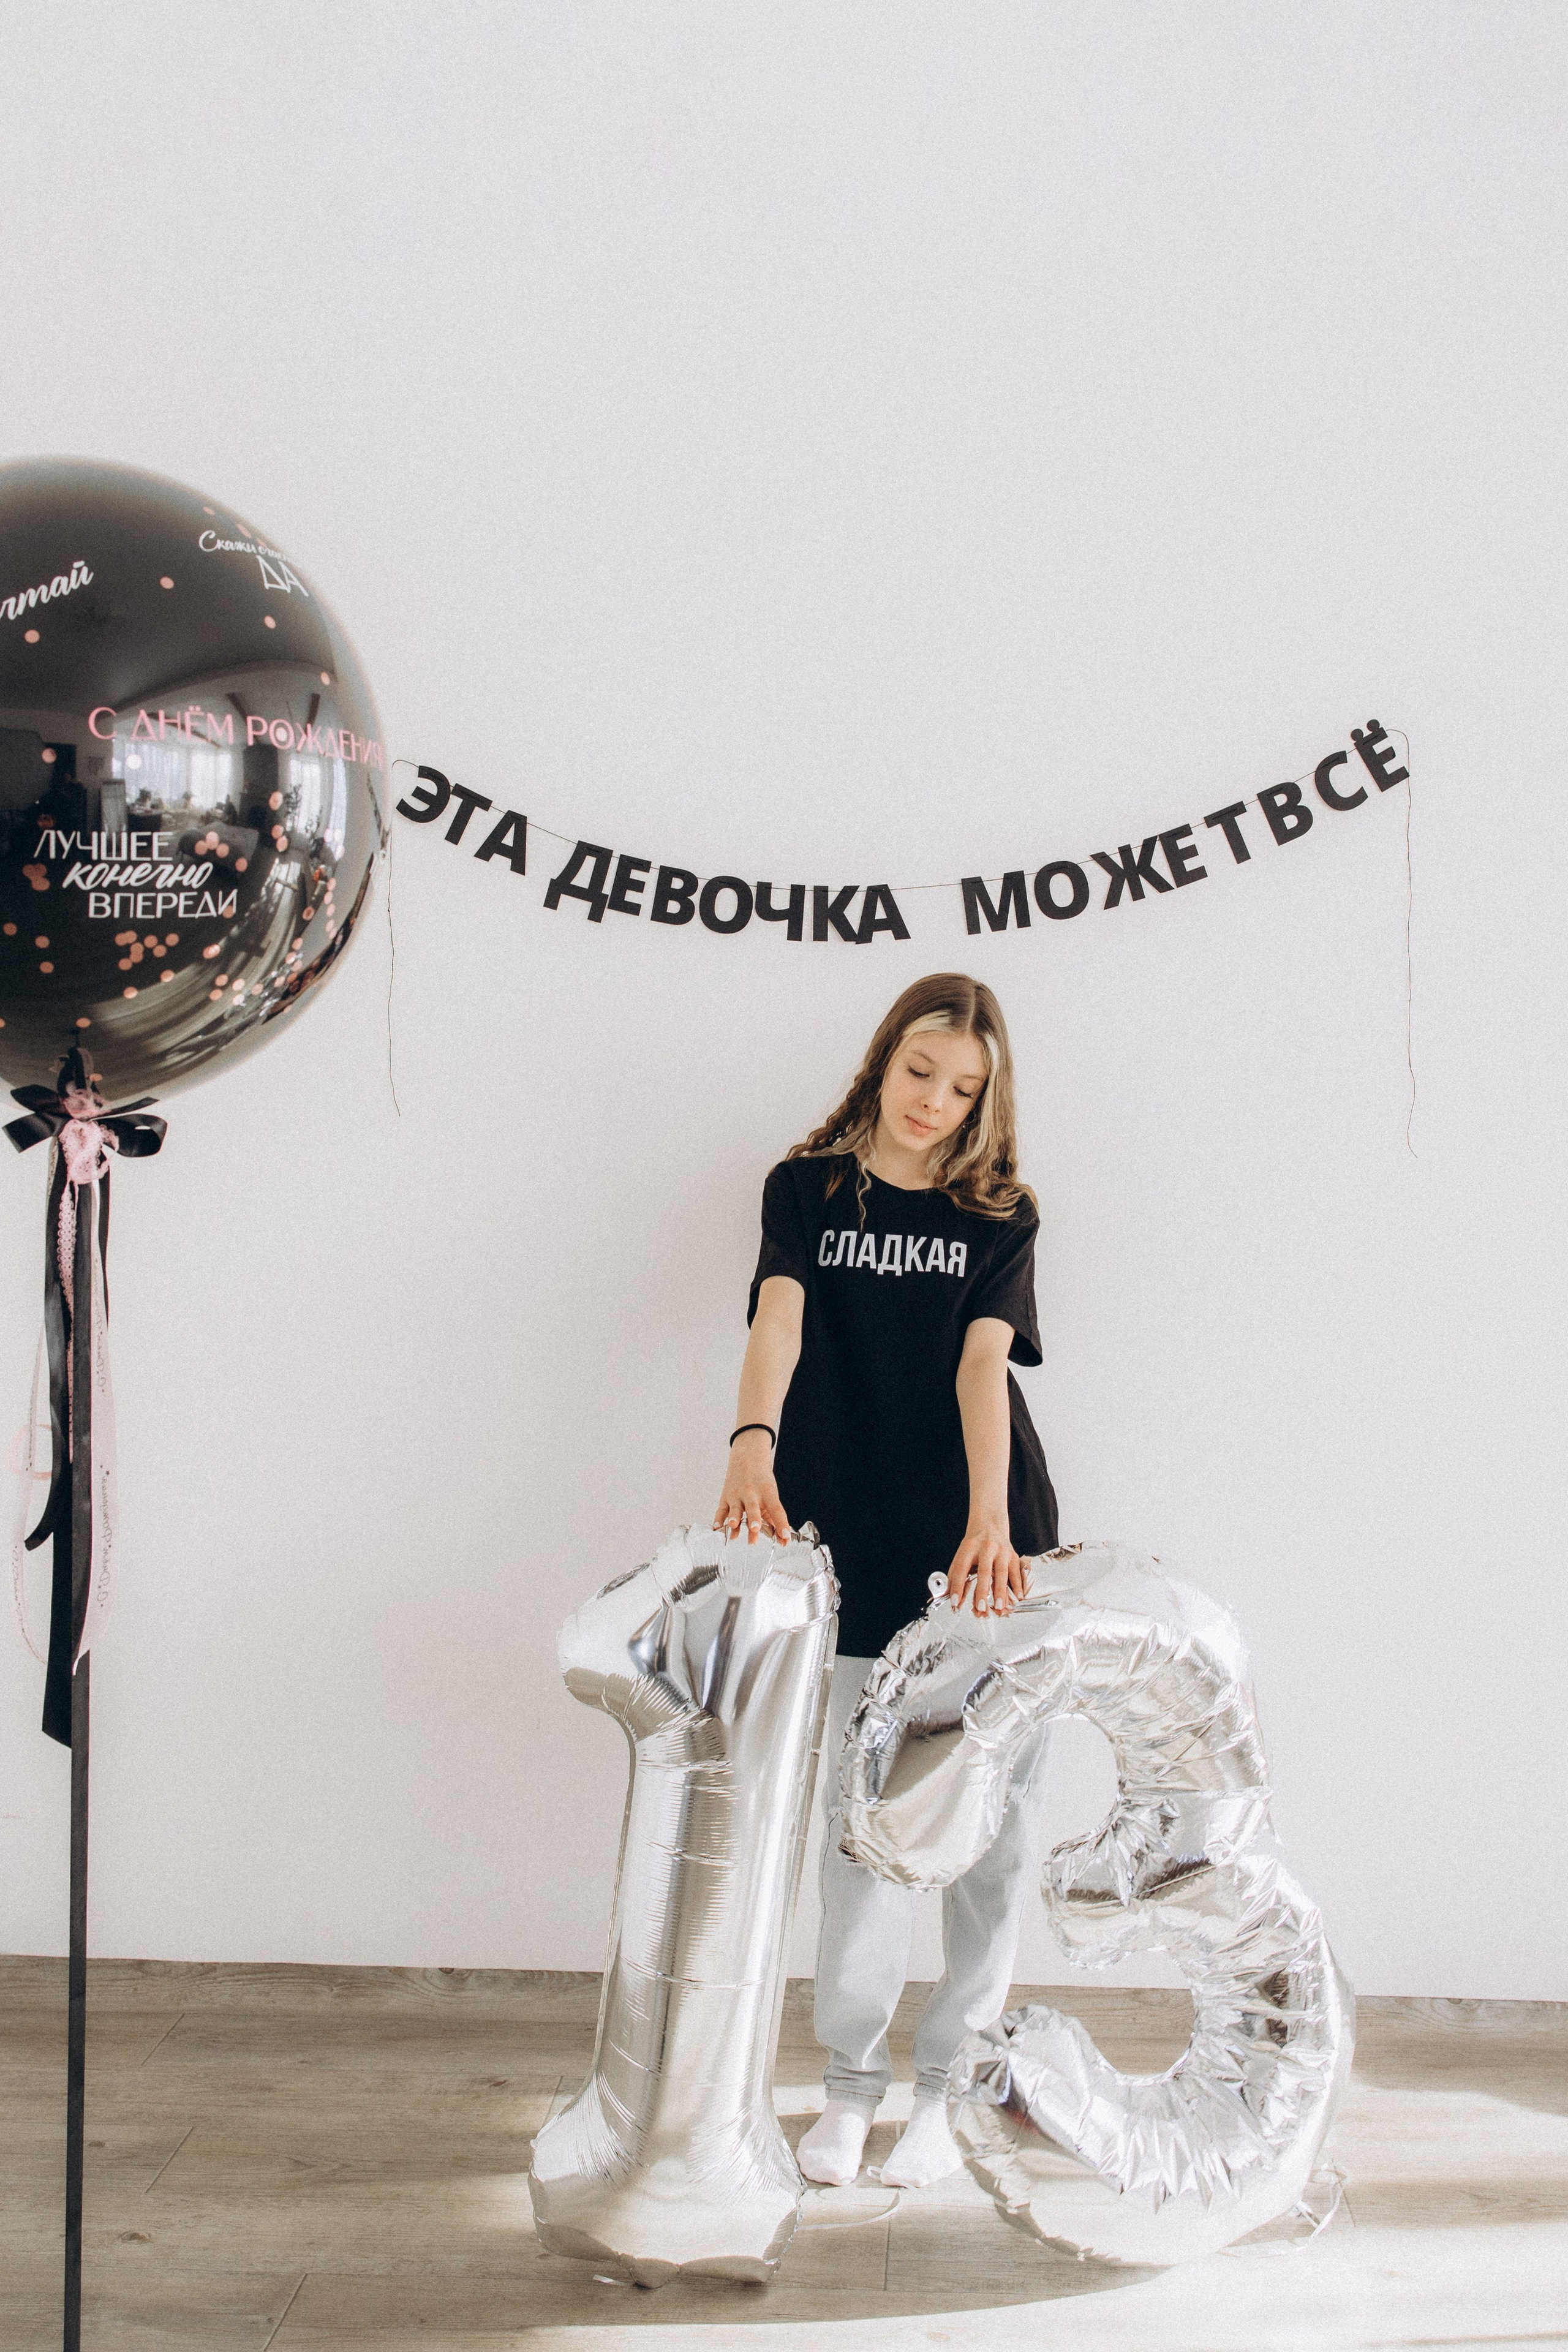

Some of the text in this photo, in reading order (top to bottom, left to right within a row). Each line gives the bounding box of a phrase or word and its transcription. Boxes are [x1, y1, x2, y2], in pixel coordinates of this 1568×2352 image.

[199, 530, 257, 554] Скажи
[0, 560, 94, 620] чтай
[256, 554, 309, 597] ДА
[88, 707, 117, 740] С
[130, 705, 234, 745] ДНЁМ
[34, 829, 174, 861] ЛУЧШЕЕ
[396, 718, 1411, 944] ЭТА ДЕВОЧКА МОЖЕТ ВСЁ
[62, 861, 214, 891] конечно
[88, 883, 238, 919] ВПЕРЕДИ
[818, 1229, 968, 1277] СЛАДКАЯ
